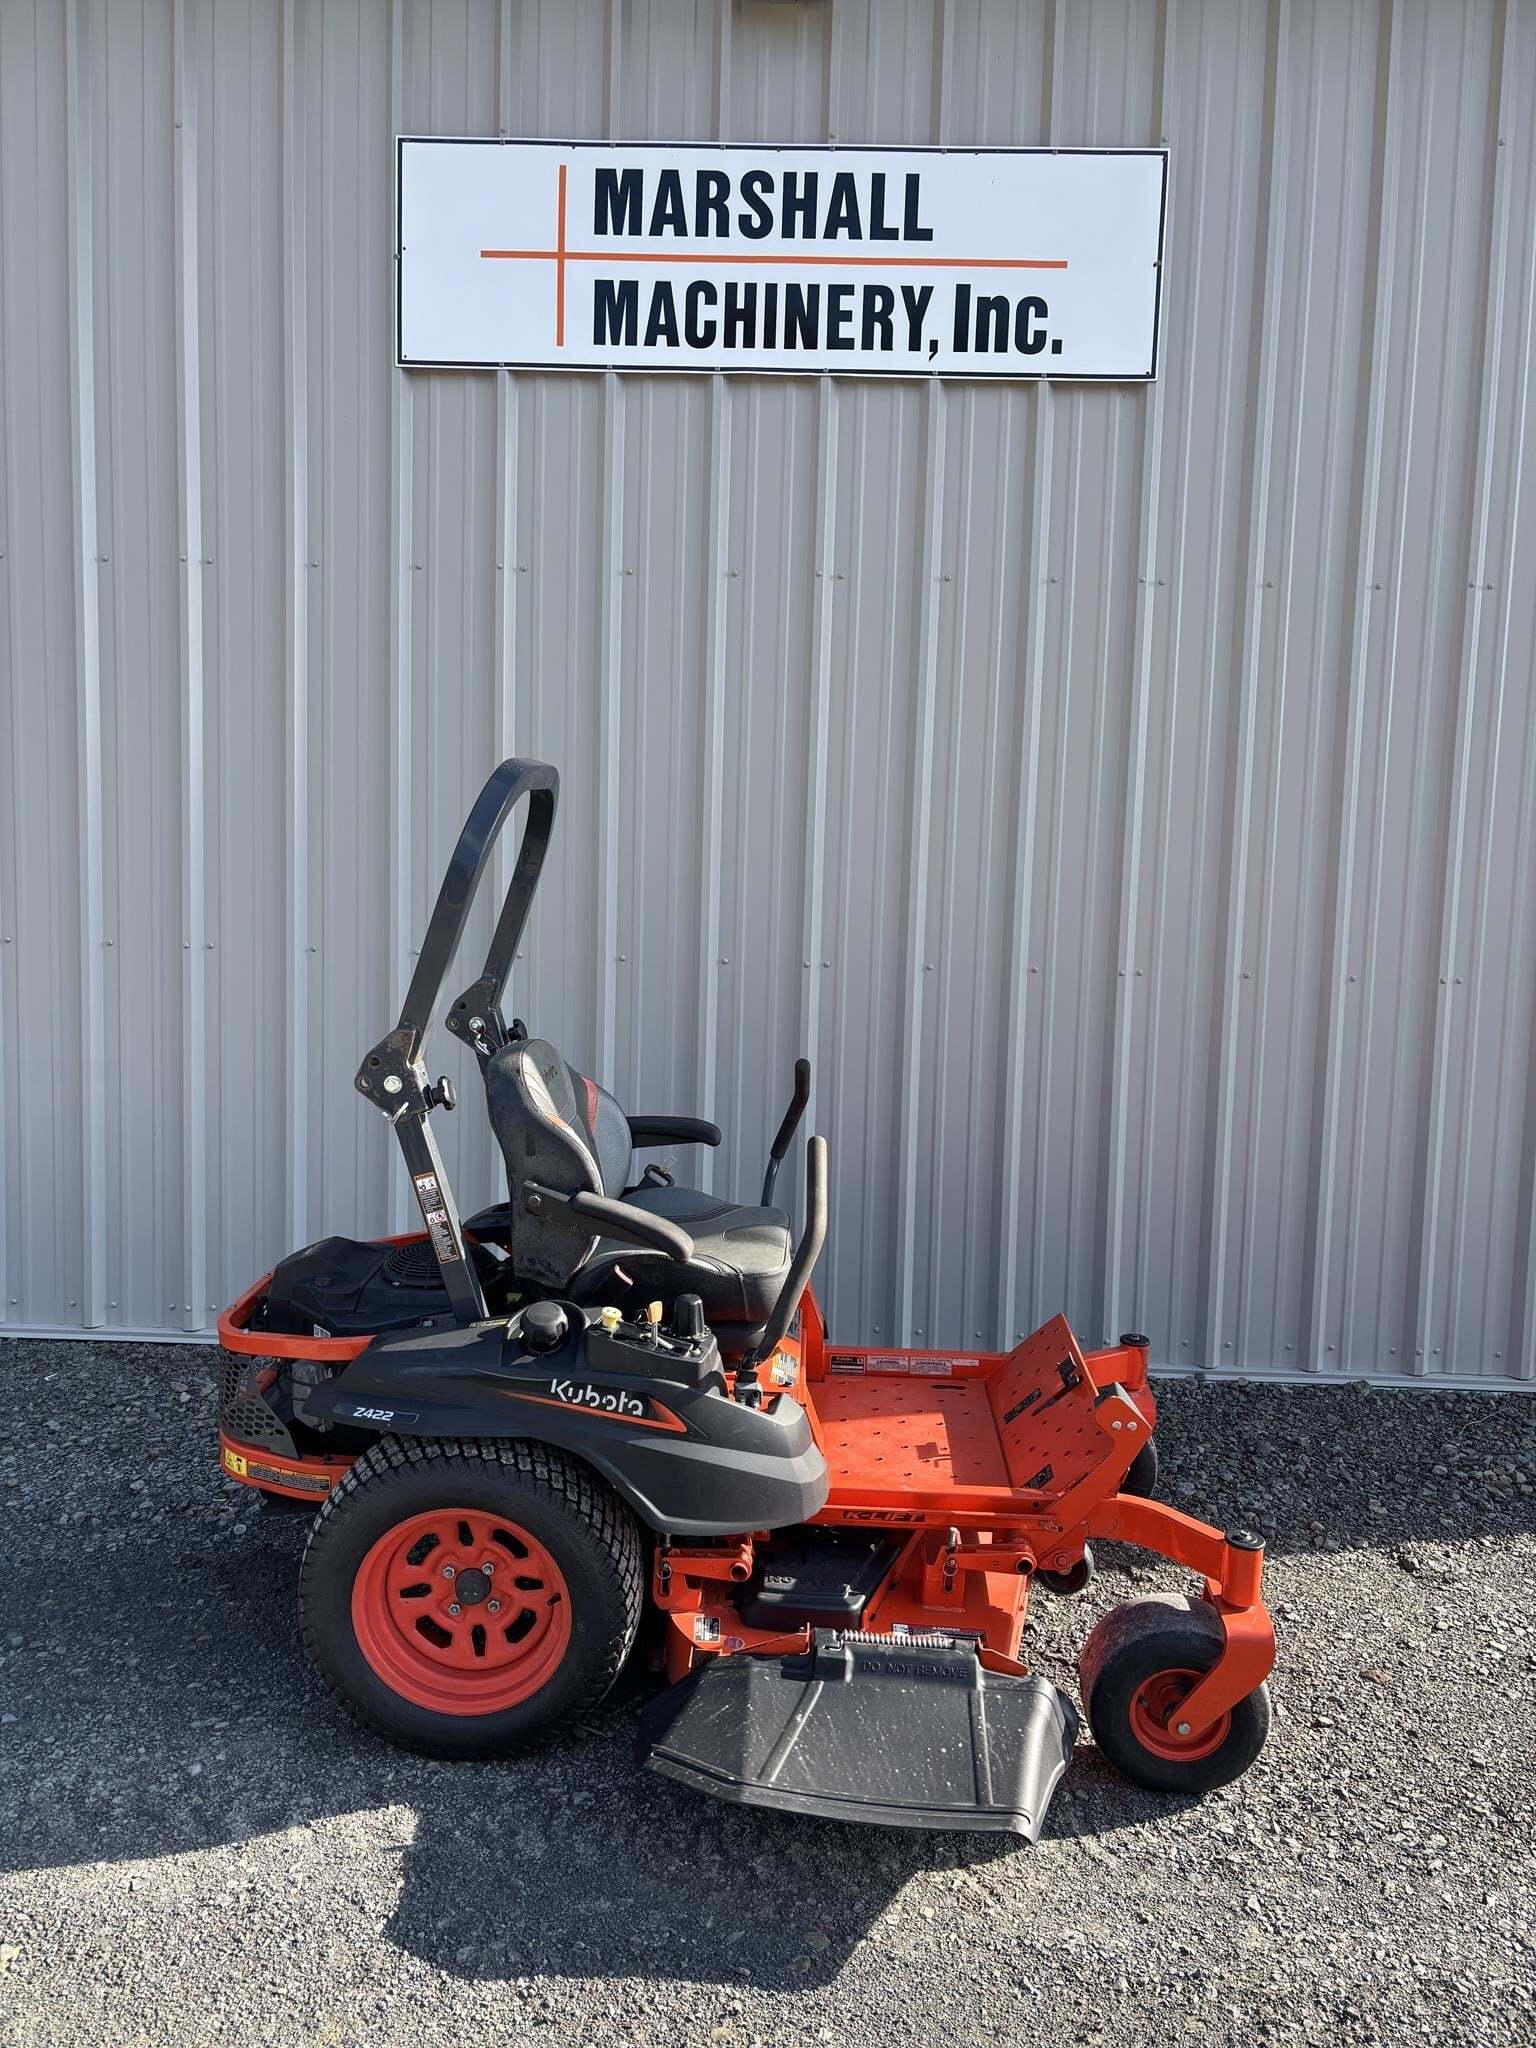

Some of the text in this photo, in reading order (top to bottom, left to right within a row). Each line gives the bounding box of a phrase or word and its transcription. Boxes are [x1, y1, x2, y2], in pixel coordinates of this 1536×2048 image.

[592, 168, 934, 242] MARSHALL
[592, 279, 1064, 362] MACHINERY, Inc.
[550, 1378, 643, 1417] Kubota
[353, 1406, 395, 1421] Z422
[845, 1511, 923, 1522] K-LIFT
[863, 1661, 967, 1678] DO NOT REMOVE
